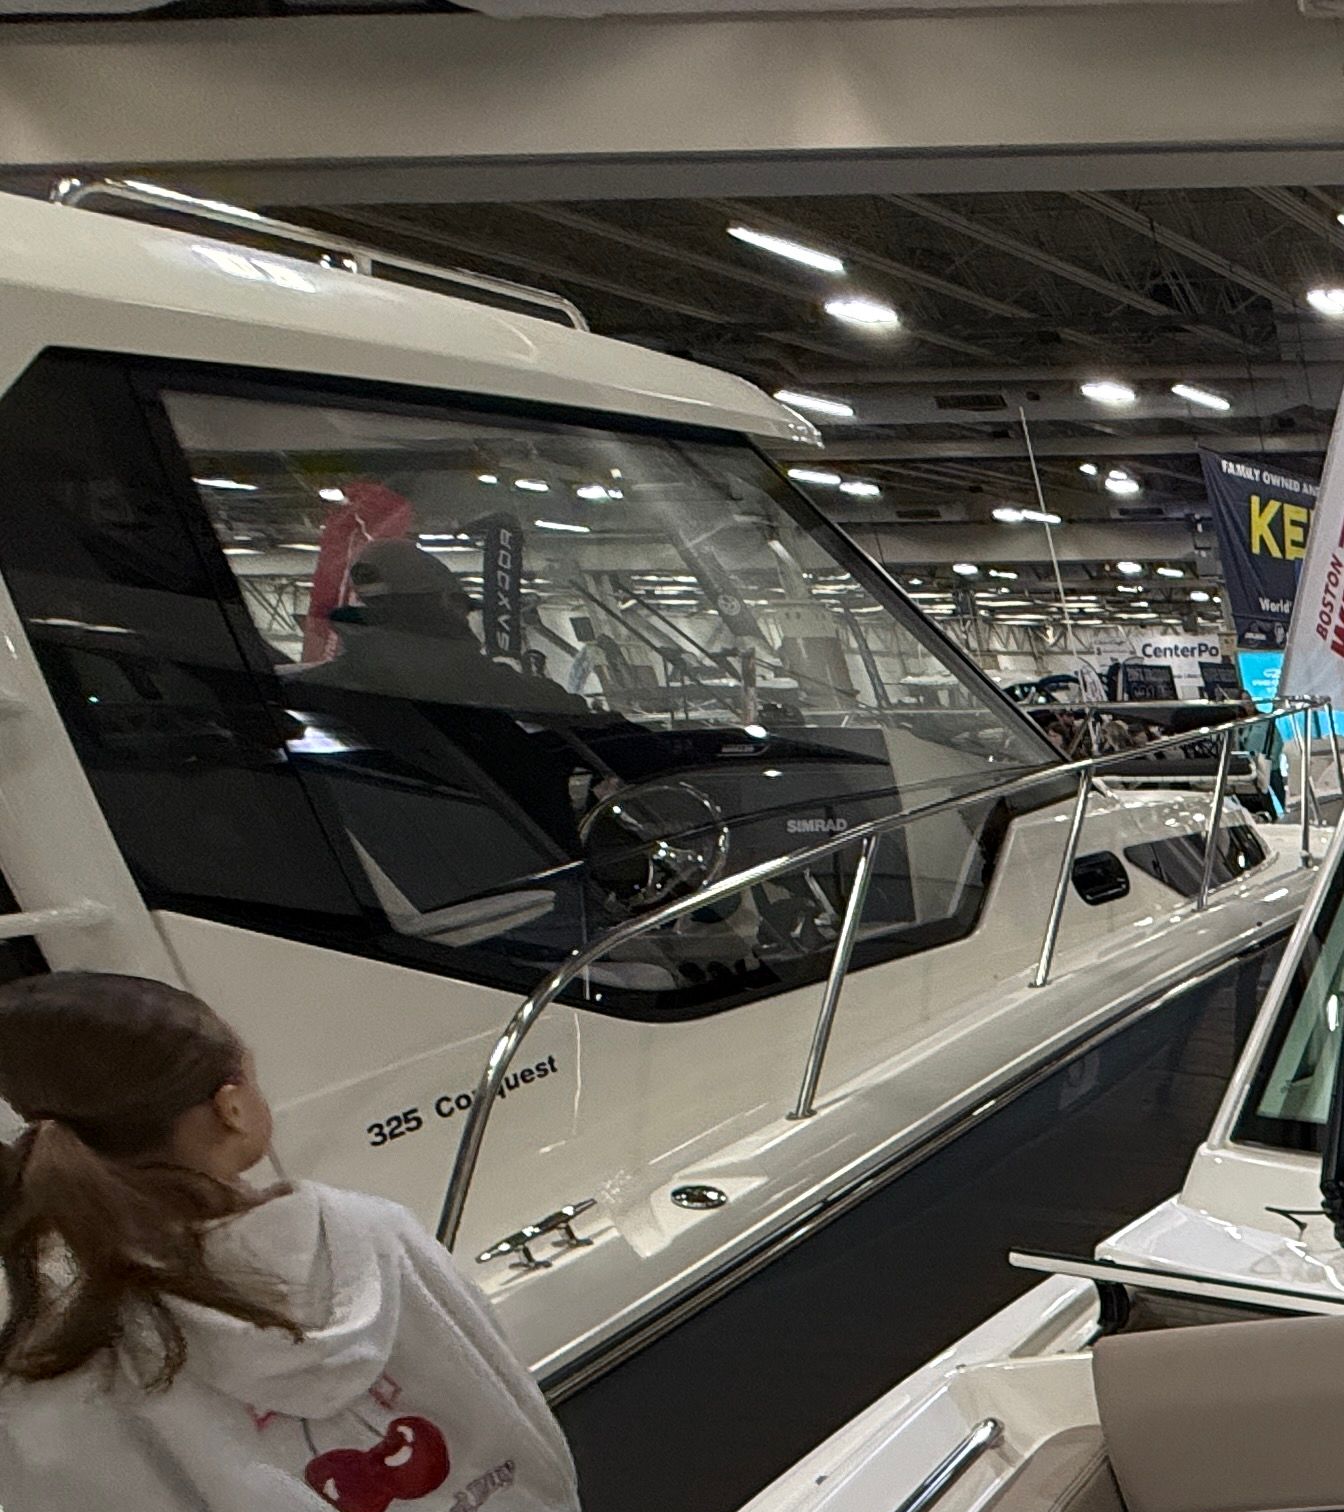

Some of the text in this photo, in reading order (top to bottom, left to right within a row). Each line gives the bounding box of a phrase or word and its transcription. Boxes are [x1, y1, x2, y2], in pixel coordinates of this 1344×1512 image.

[1221, 460, 1260, 482] FAMILY
[1263, 471, 1300, 494] OWNED
[1251, 494, 1315, 560] KE
[1259, 597, 1292, 614] World'
[1316, 553, 1344, 641] BOSTON
[1141, 642, 1220, 659] CenterPo
[786, 818, 848, 834] SIMRAD
[366, 1055, 559, 1147] 325 Couest
